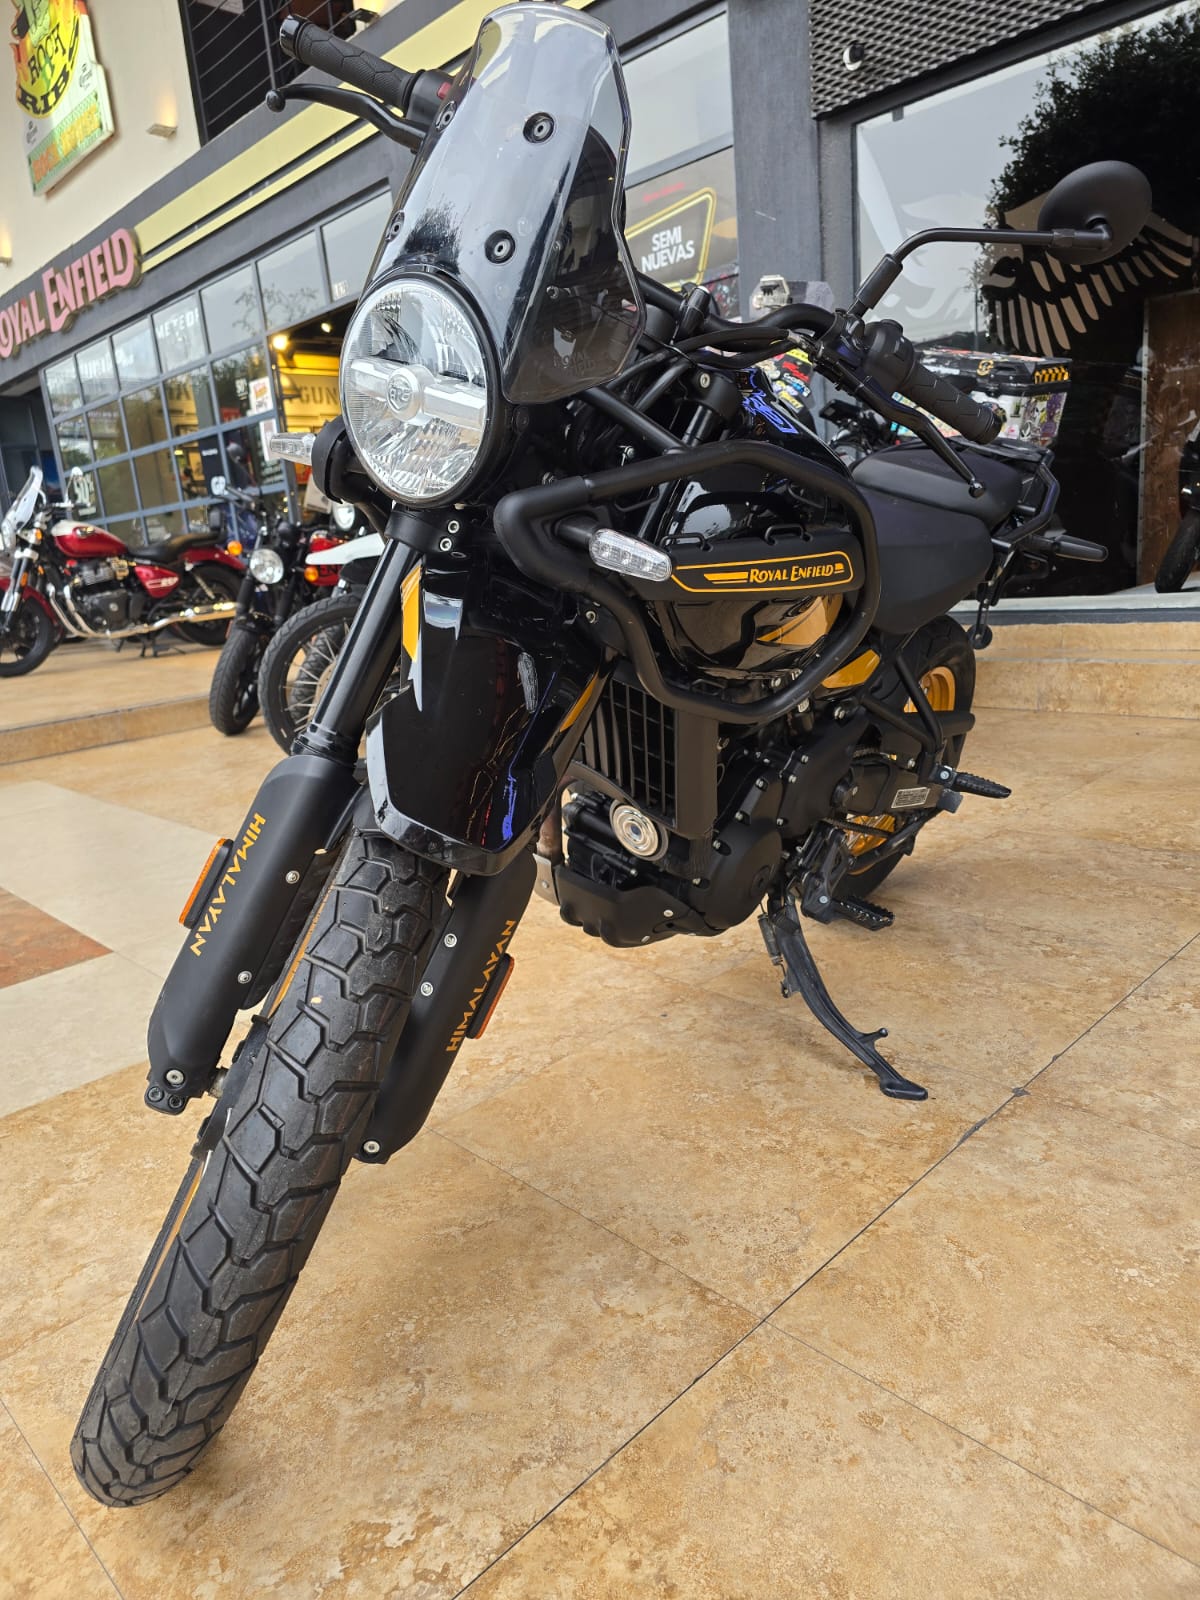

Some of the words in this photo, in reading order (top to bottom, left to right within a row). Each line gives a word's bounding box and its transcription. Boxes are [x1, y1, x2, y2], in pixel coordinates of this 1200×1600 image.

[651, 225, 682, 252] SEMI
[640, 240, 696, 274] NUEVAS
[0, 290, 46, 358] OYAL
[41, 228, 135, 332] ENFIELD
[300, 387, 339, 405] GUN
[749, 568, 789, 584] ROYAL
[790, 564, 834, 582] ENFIELD
[189, 812, 266, 957] HIMALAYAN
[445, 919, 517, 1052] HIMALAYAN
